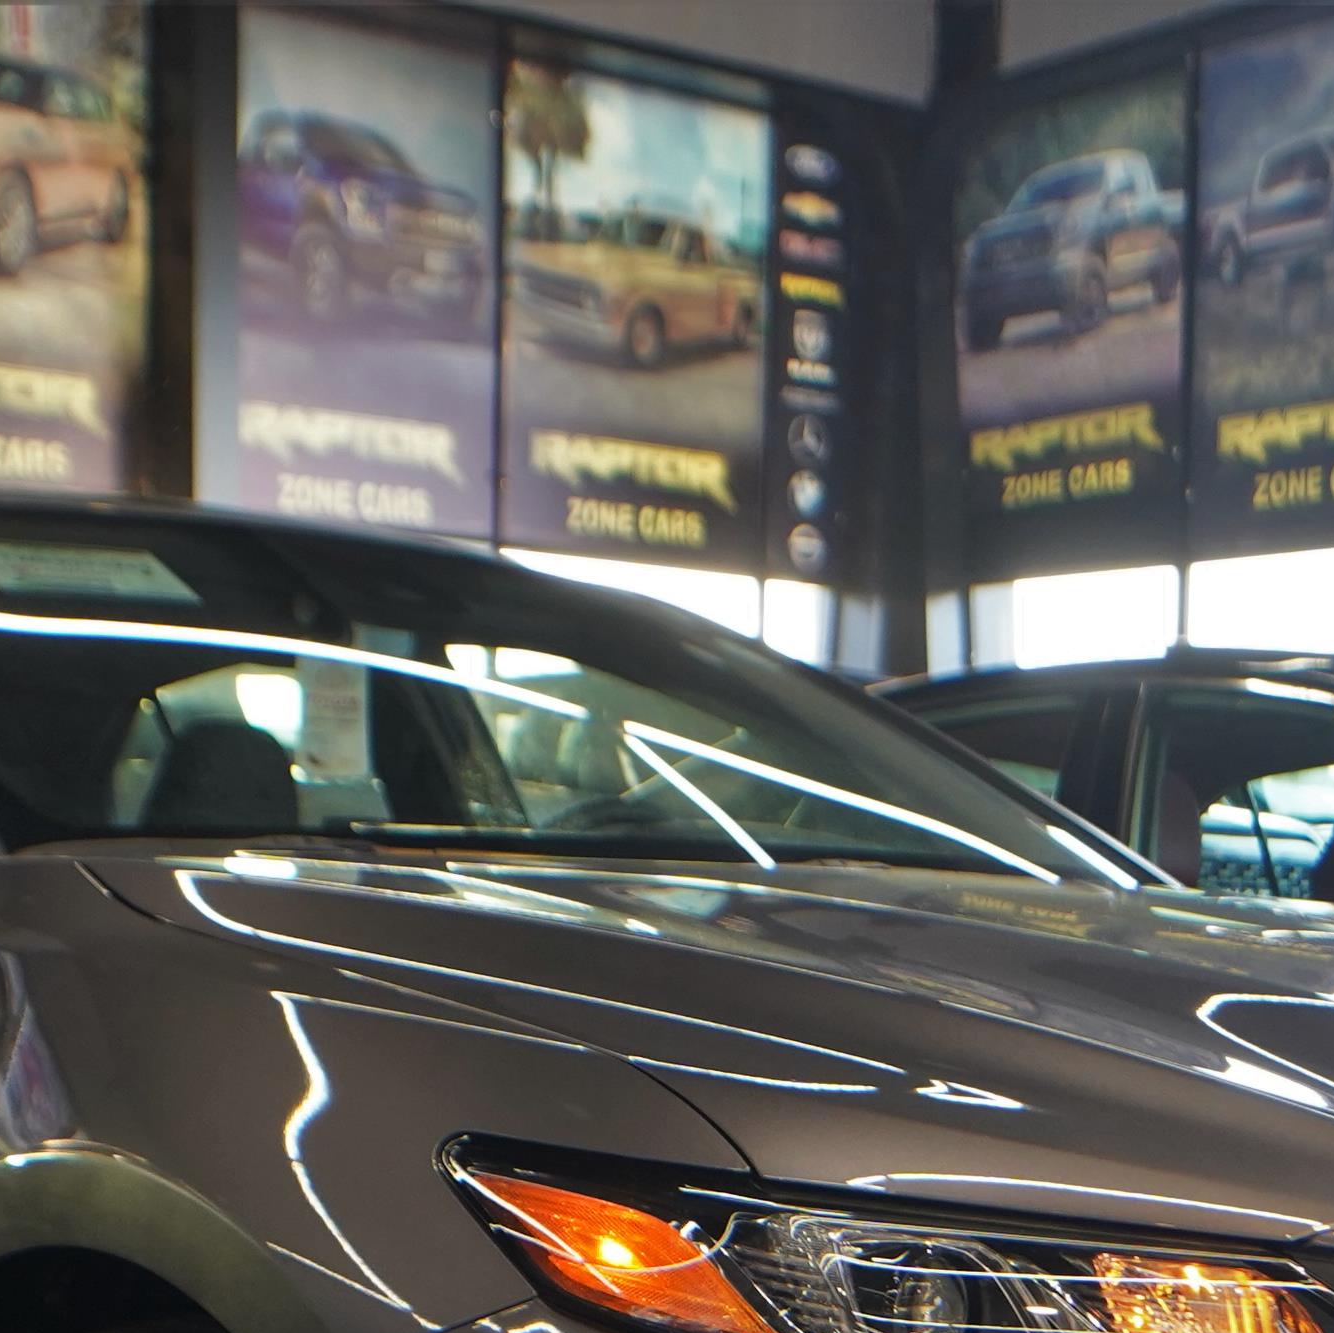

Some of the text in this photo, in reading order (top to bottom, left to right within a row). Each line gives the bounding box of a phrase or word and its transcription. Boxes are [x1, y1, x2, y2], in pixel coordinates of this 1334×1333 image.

[970, 401, 1165, 471] RAPTOR
[529, 427, 738, 513] RAPTOR
[1001, 457, 1133, 509] ZONE CARS
[1252, 465, 1322, 510] ZONE
[276, 472, 434, 528] ZONE CARS
[567, 497, 707, 548] ZONE CARS
